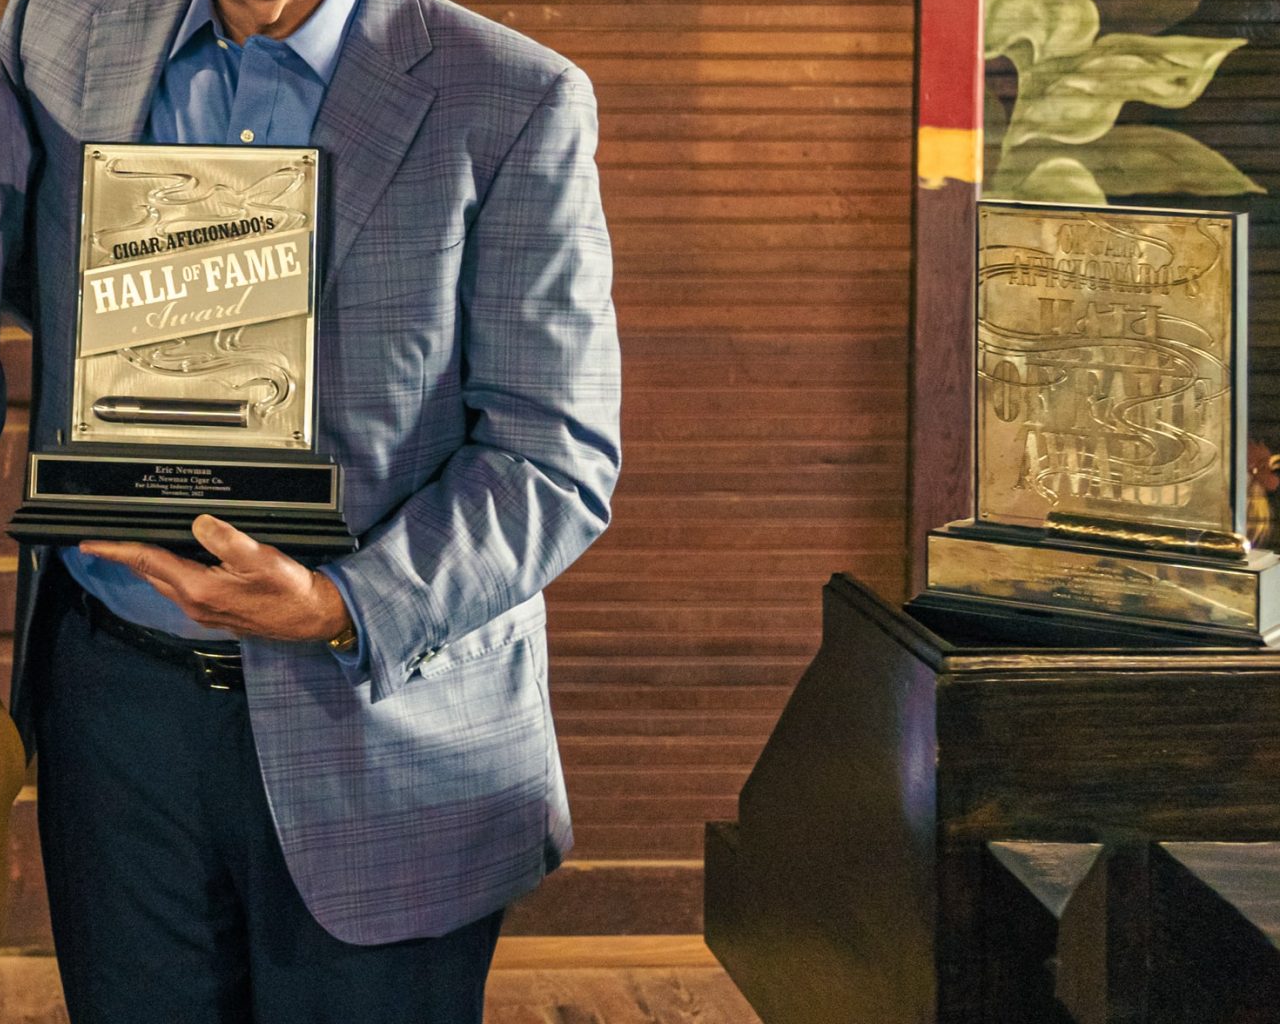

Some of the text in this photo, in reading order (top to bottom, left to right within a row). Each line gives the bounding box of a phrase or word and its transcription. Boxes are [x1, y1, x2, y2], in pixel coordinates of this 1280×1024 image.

[113, 215, 275, 260] CIGAR AFICIONADO's
[90, 241, 302, 314] HALL OF FAME
[131, 286, 254, 334] Award
[155, 465, 212, 475] Eric Newman
[158, 475, 188, 483] Newman
